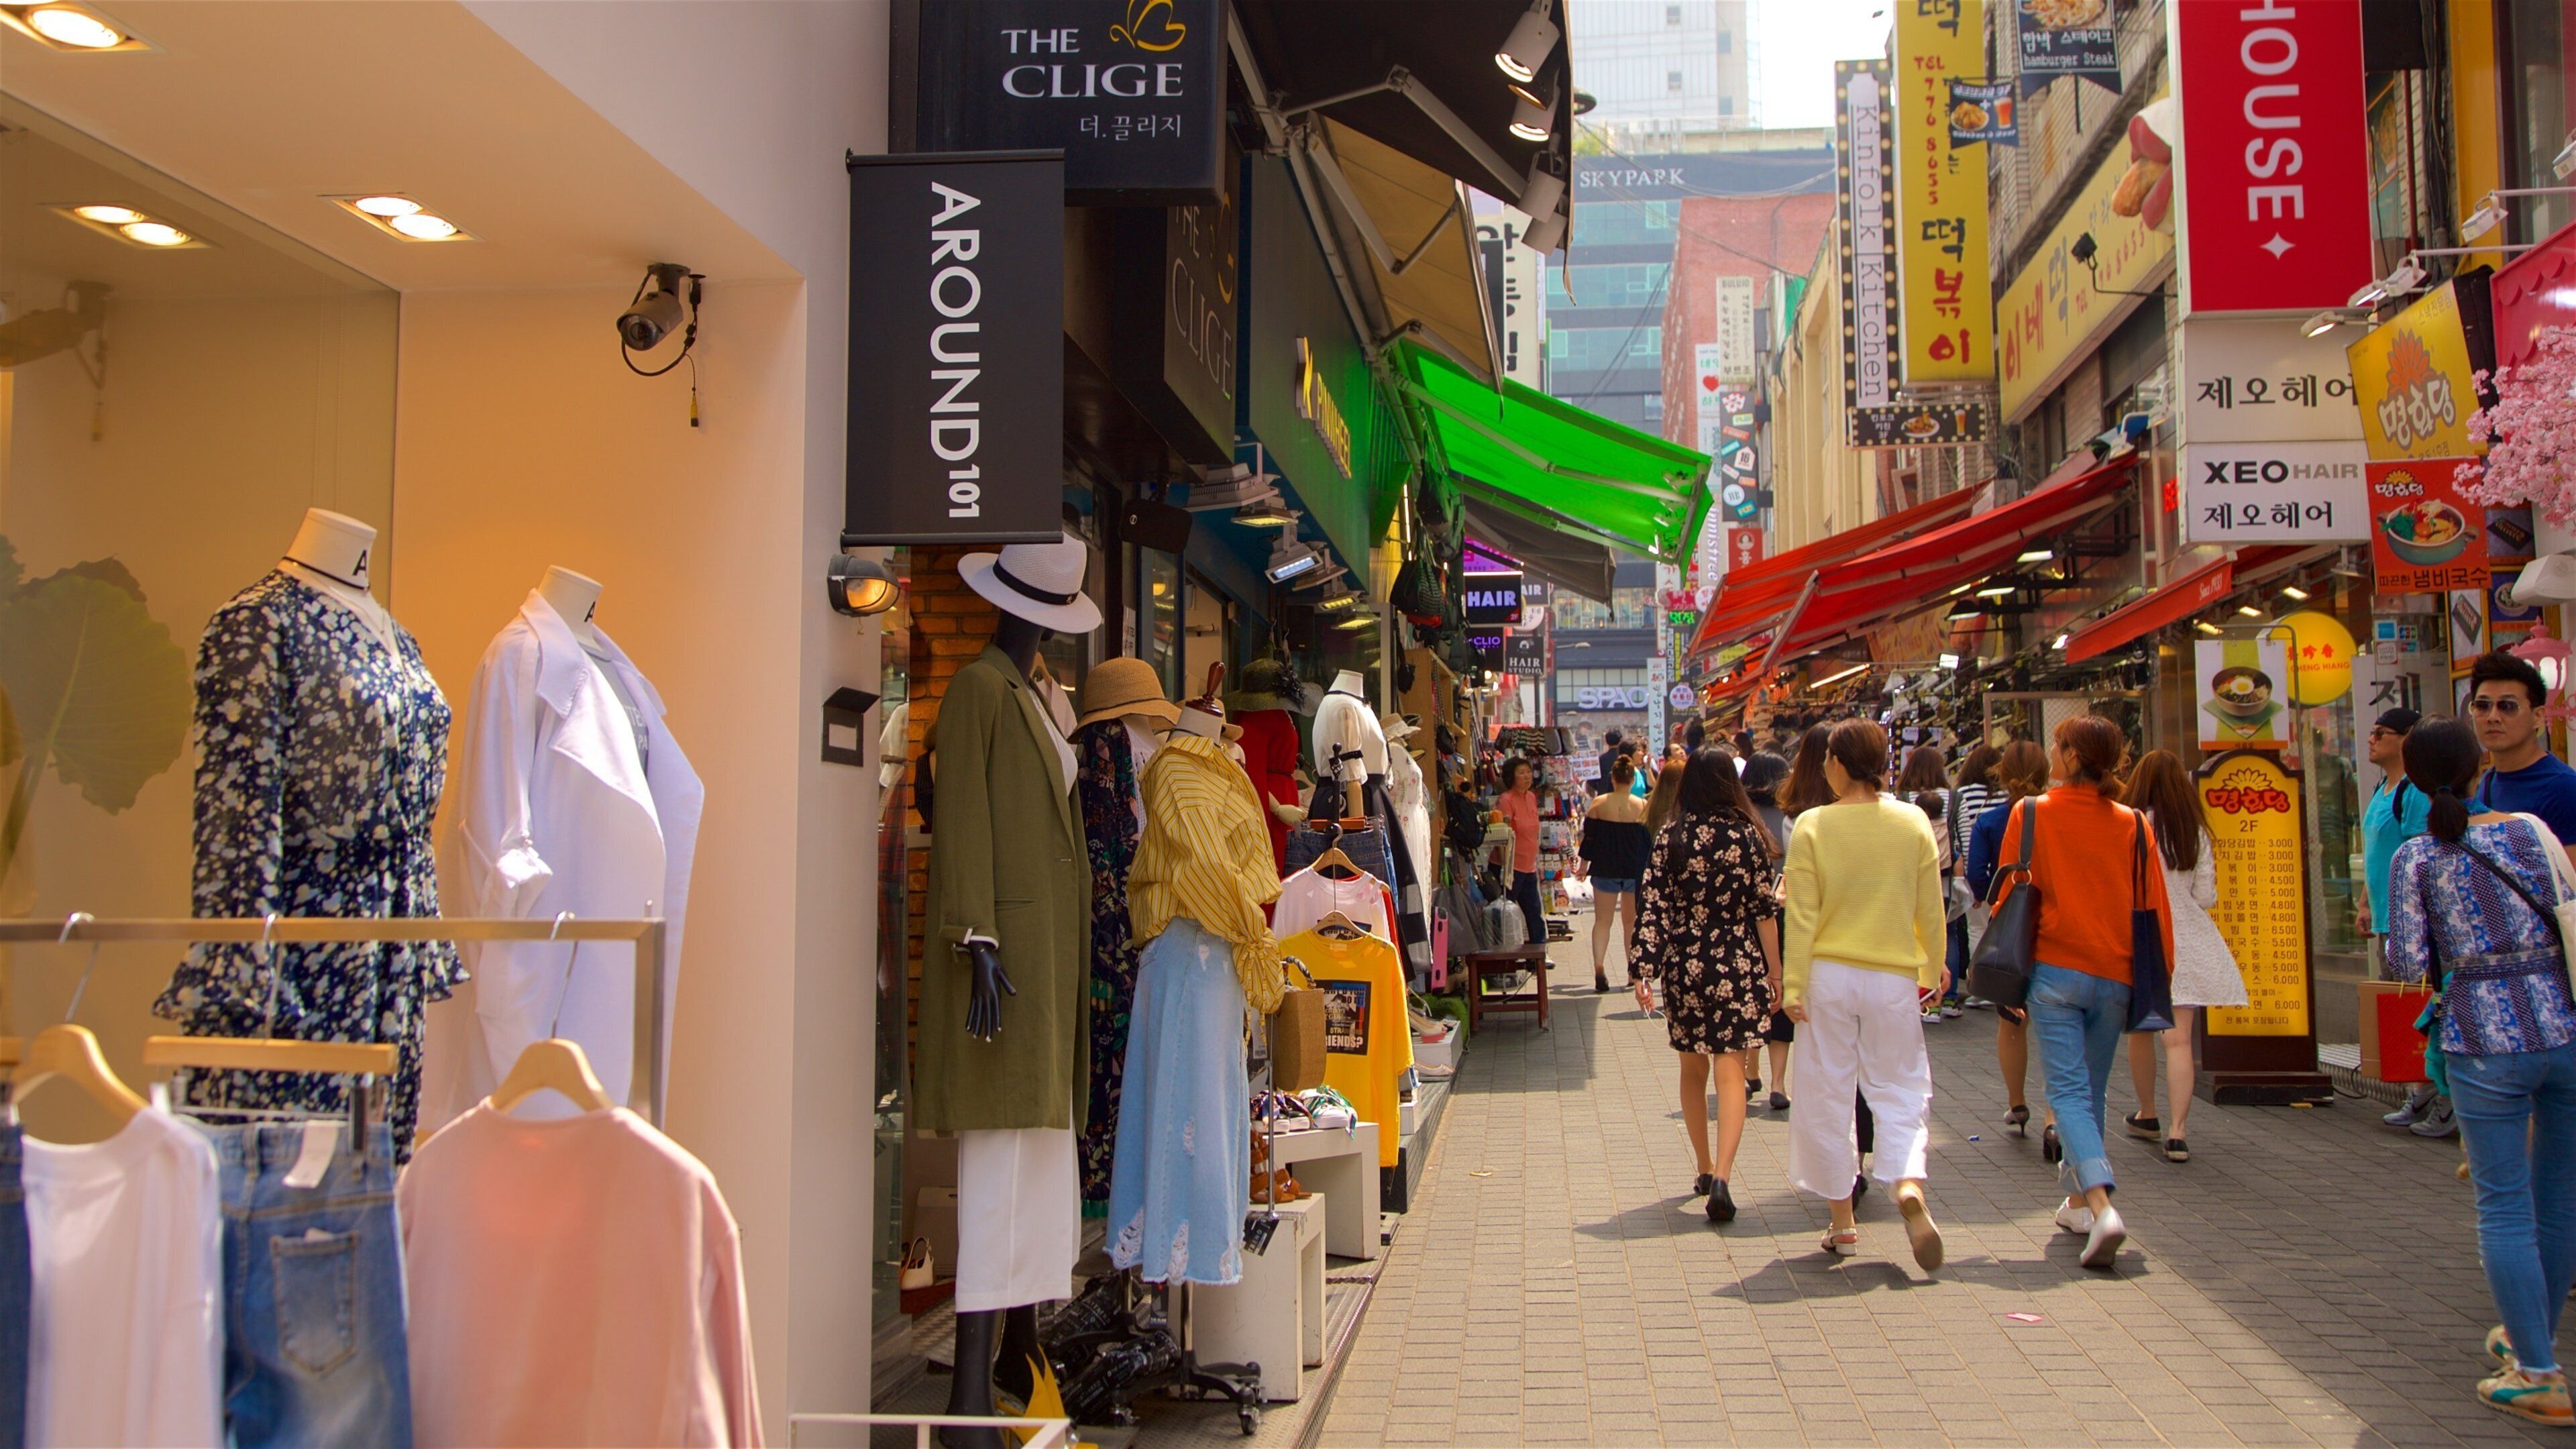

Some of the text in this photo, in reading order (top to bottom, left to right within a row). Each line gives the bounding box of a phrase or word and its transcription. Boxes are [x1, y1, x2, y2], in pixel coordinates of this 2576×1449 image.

[1000, 28, 1081, 54] THE
[2022, 30, 2113, 54] 함박 스테이크
[1914, 56, 1945, 70] TEL
[2024, 51, 2115, 68] hamburger Steak
[1002, 63, 1184, 98] CLIGE
[1079, 115, 1181, 141] 더.끌리지
[1579, 168, 1686, 188] SKYPARK
[1856, 105, 1881, 240] Kinfolk
[1922, 217, 1970, 364] 떡볶이
[1173, 258, 1232, 401] CLIGE
[1860, 261, 1886, 398] Kitchen
[2197, 374, 2359, 409] 제오헤어
[2204, 501, 2332, 529] 제오헤어
[1707, 507, 1719, 581] innisfree
[2414, 568, 2489, 588] 냄비국수
[1467, 590, 1517, 607] HAIR
[1473, 637, 1501, 645] CLIO
[1509, 657, 1541, 667] HAIR
[2323, 661, 2351, 670] HIANG
[1578, 686, 1649, 709] SPAO
[2239, 820, 2259, 833] 2F
